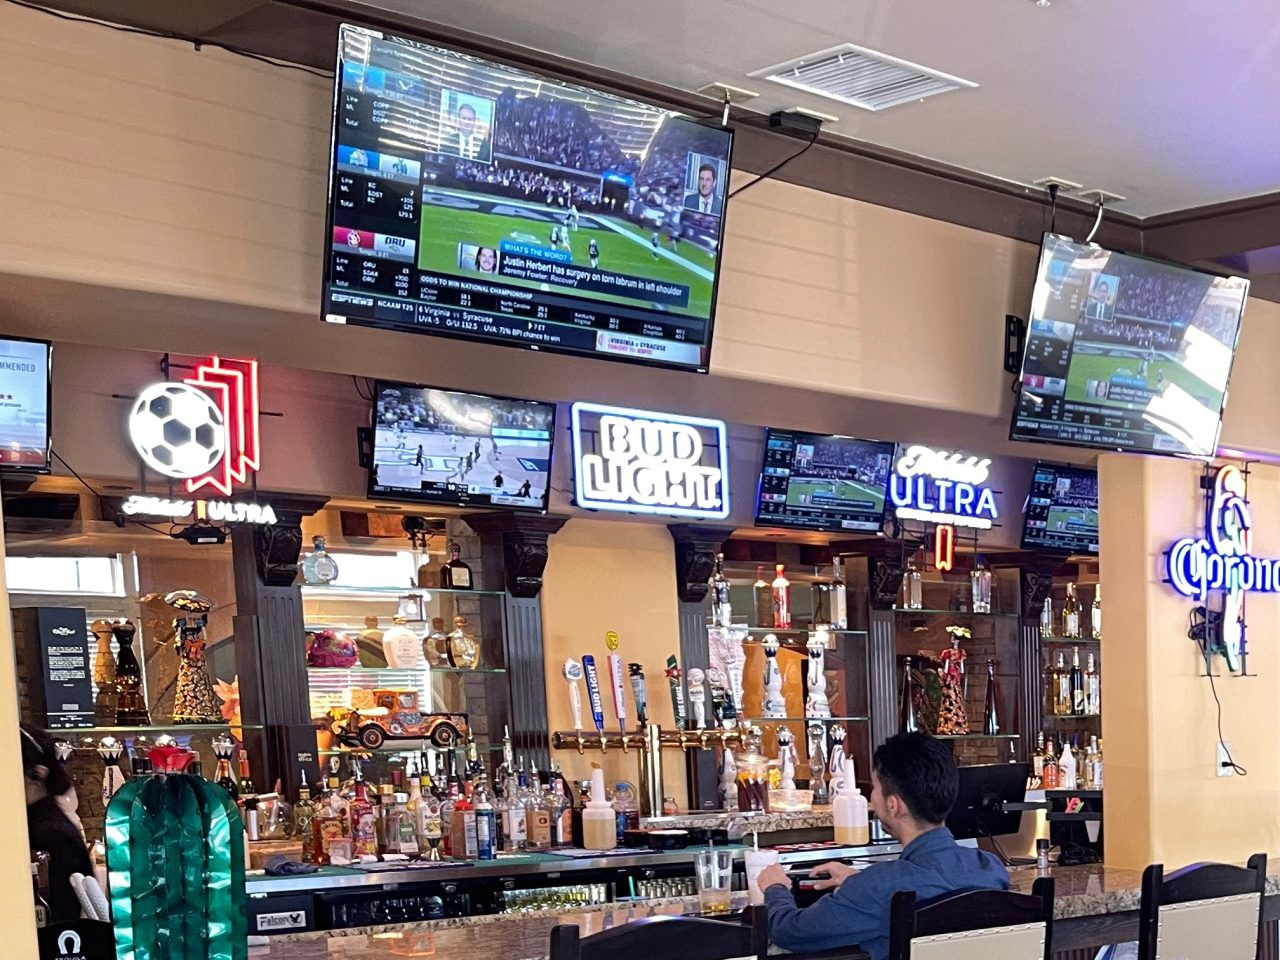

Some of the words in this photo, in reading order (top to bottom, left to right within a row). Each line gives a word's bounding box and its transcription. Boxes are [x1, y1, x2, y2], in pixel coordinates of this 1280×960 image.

[530, 248, 544, 256] THE
[545, 250, 568, 260] WORD?
[504, 256, 525, 268] Justin
[526, 260, 551, 274] Herbert
[552, 264, 566, 275] has
[566, 268, 591, 282] surgery
[592, 273, 600, 282] on
[602, 274, 614, 284] torn
[616, 276, 638, 288] labrum
[638, 280, 644, 289] in
[646, 282, 656, 292] left
[656, 283, 682, 296] shoulder
[550, 274, 578, 287] Recovery
[438, 278, 448, 286] TO
[460, 280, 489, 293] NATIONAL
[490, 284, 533, 300] CHAMPIONSHIP
[424, 306, 450, 318] Virginia
[462, 313, 493, 324] Syracuse
[462, 321, 478, 330] 132.5
[522, 330, 544, 340] chance
[600, 415, 702, 466] BUD
[582, 454, 722, 508] LIGHT
[890, 473, 998, 519] ULTRA
[208, 500, 278, 525] ULTRA
[587, 664, 600, 692] LIGHT
[592, 694, 602, 713] BUD
[260, 916, 288, 928] Falcon
